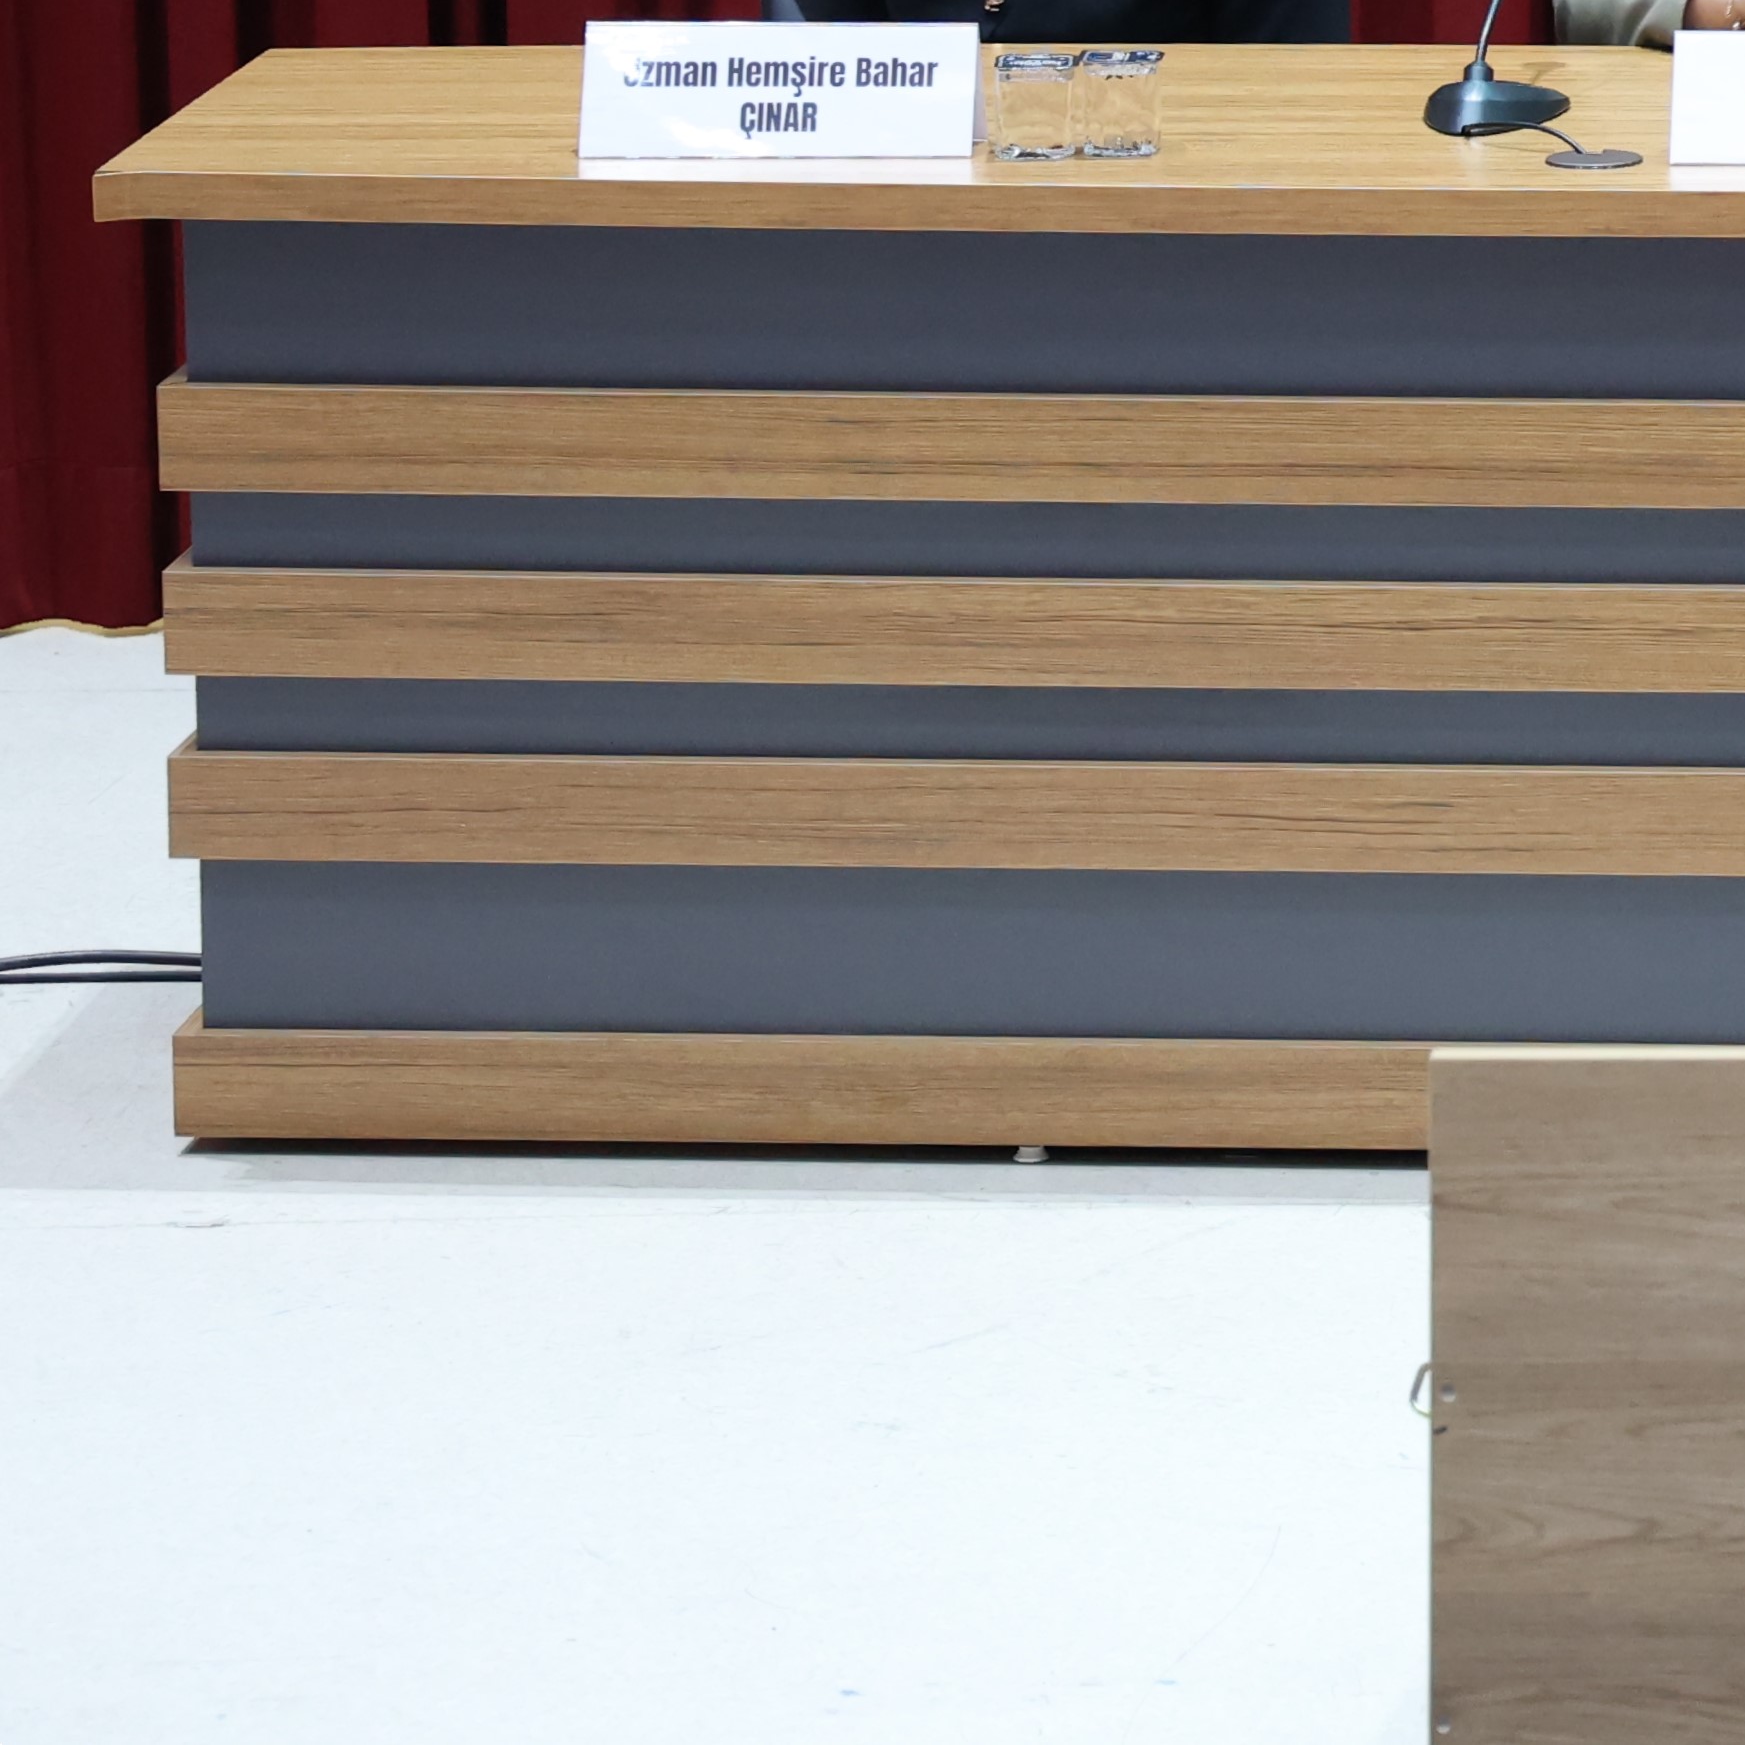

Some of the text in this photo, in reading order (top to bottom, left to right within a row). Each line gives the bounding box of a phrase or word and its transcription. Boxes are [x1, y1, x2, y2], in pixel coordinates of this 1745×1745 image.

[727, 56, 845, 98] Hemşire
[855, 57, 938, 88] Bahar
[740, 101, 817, 140] ÇINAR
